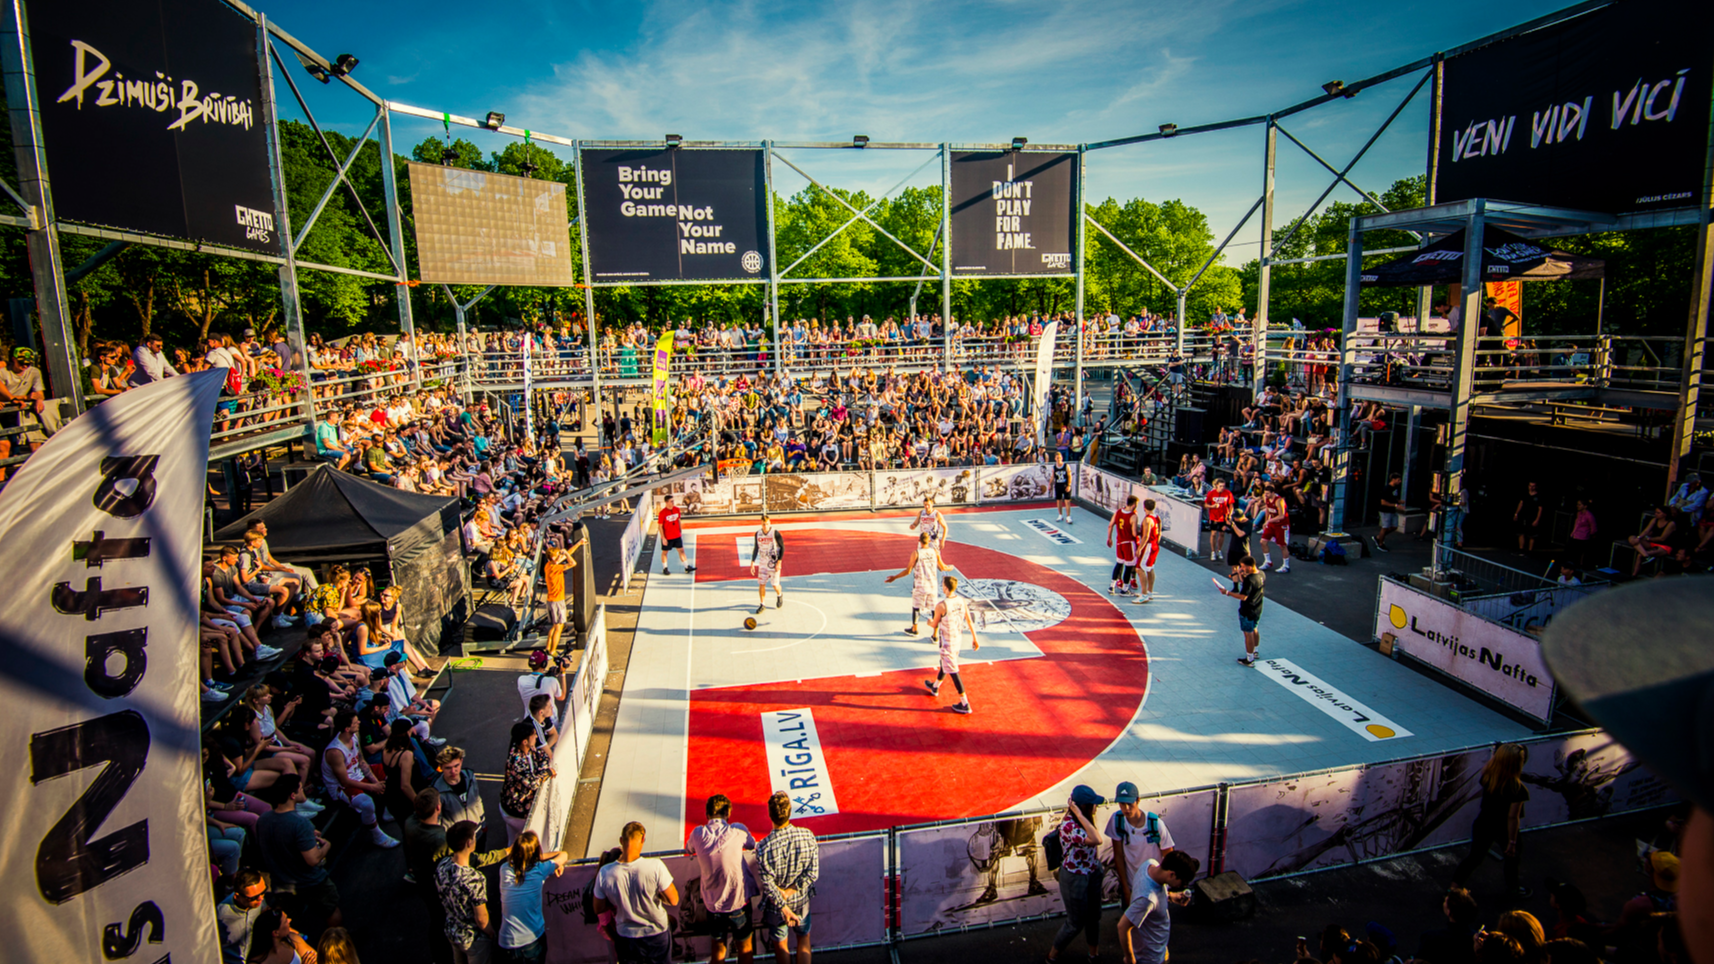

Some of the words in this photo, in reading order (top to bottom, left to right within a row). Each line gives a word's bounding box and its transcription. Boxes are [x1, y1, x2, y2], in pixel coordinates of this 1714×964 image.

[1452, 115, 1516, 163] VENI
[1530, 96, 1593, 149] VIDI
[618, 165, 672, 186] Bring
[618, 184, 664, 201] Your
[992, 181, 1033, 200] DON'T
[620, 201, 678, 218] Game
[678, 205, 714, 221] Not
[996, 199, 1032, 216] PLAY
[235, 204, 274, 232] GHETTO
[996, 216, 1021, 233] FOR
[678, 222, 723, 238] Your
[680, 239, 736, 255] Name
[1411, 615, 1476, 660] Latvijas
[1478, 646, 1538, 687] Nafta
[29, 454, 161, 906] Nafta
[1265, 659, 1310, 686] Nafta
[1307, 684, 1371, 724] Latvijas
[365, 734, 373, 744] 3
[776, 712, 819, 790] RĪGA.LV
